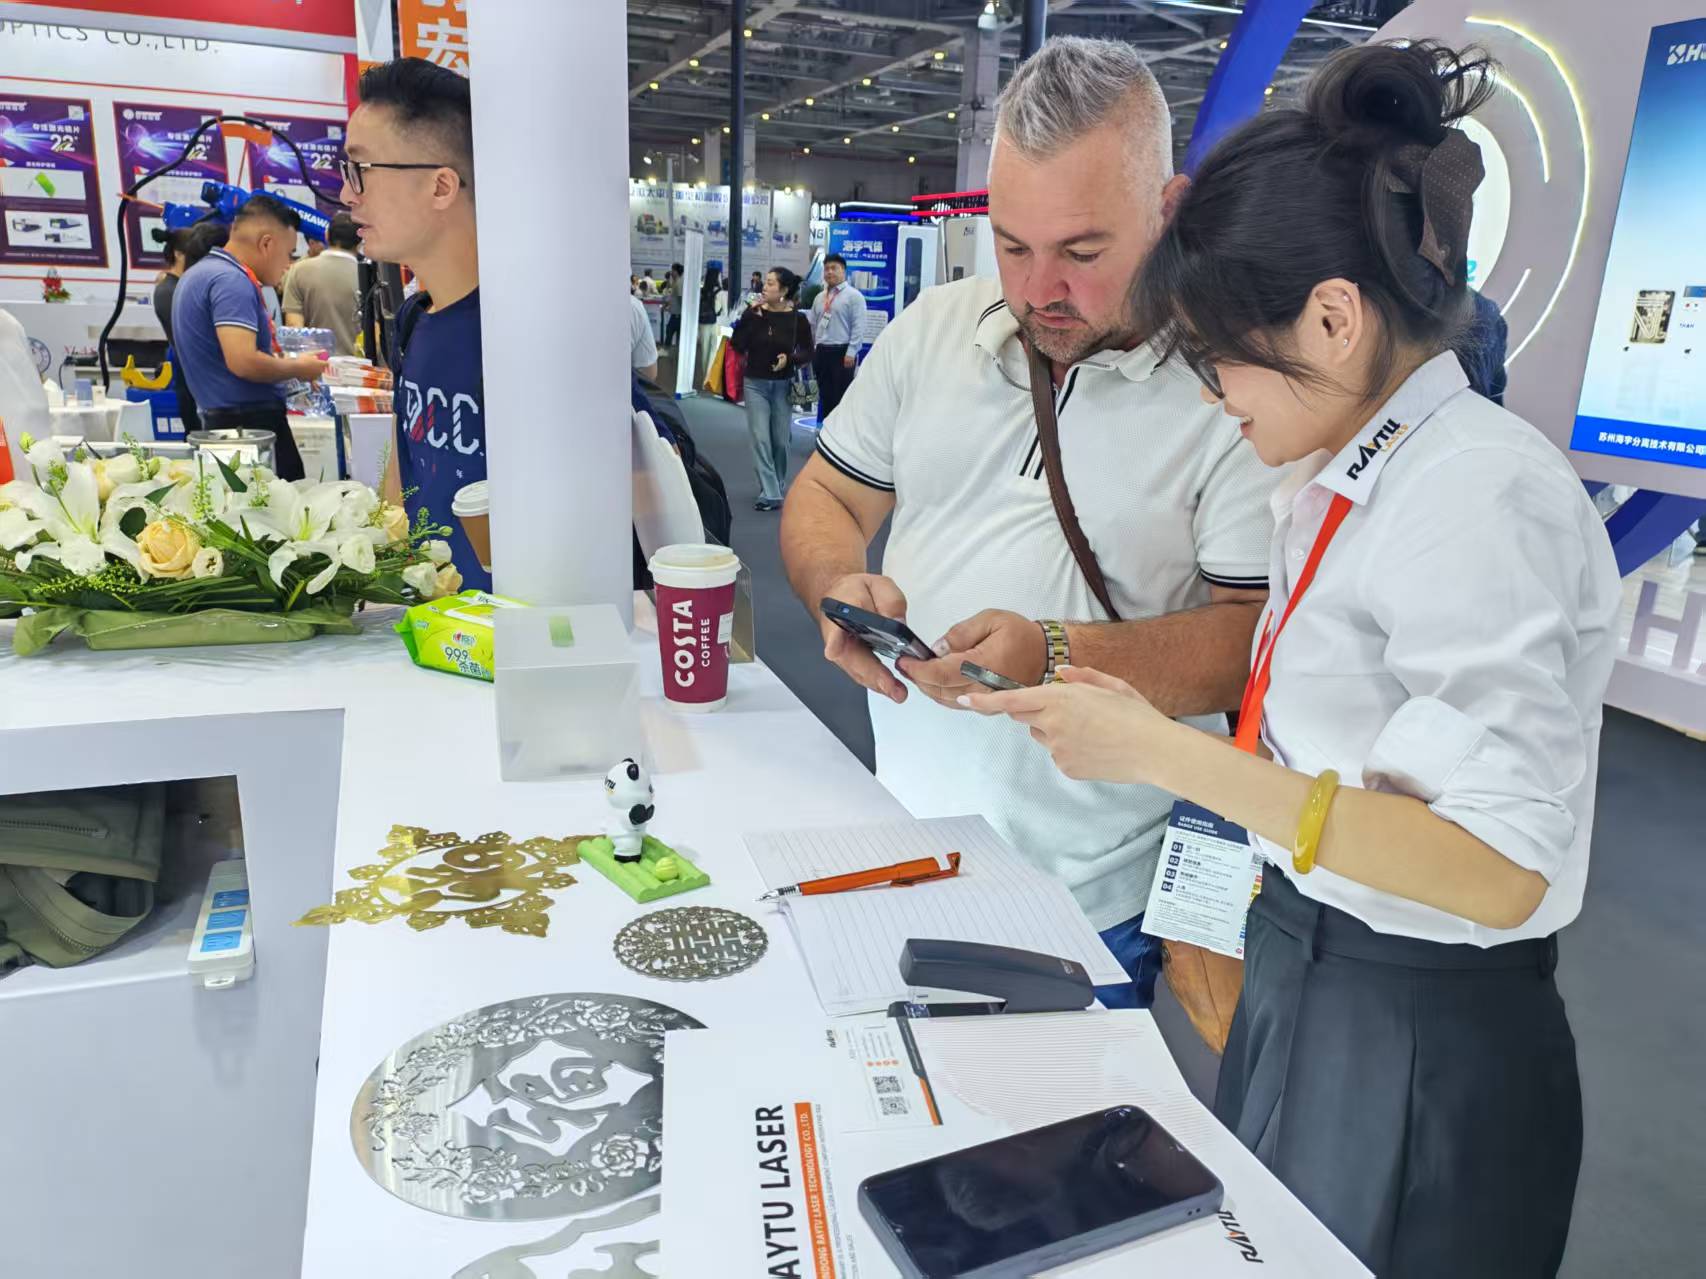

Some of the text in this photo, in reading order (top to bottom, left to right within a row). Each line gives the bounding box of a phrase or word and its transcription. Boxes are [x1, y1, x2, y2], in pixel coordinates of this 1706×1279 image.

[672, 600, 697, 687] COSTA
[700, 618, 711, 667] COFFEE
[755, 1105, 803, 1279] AYTU LASER
